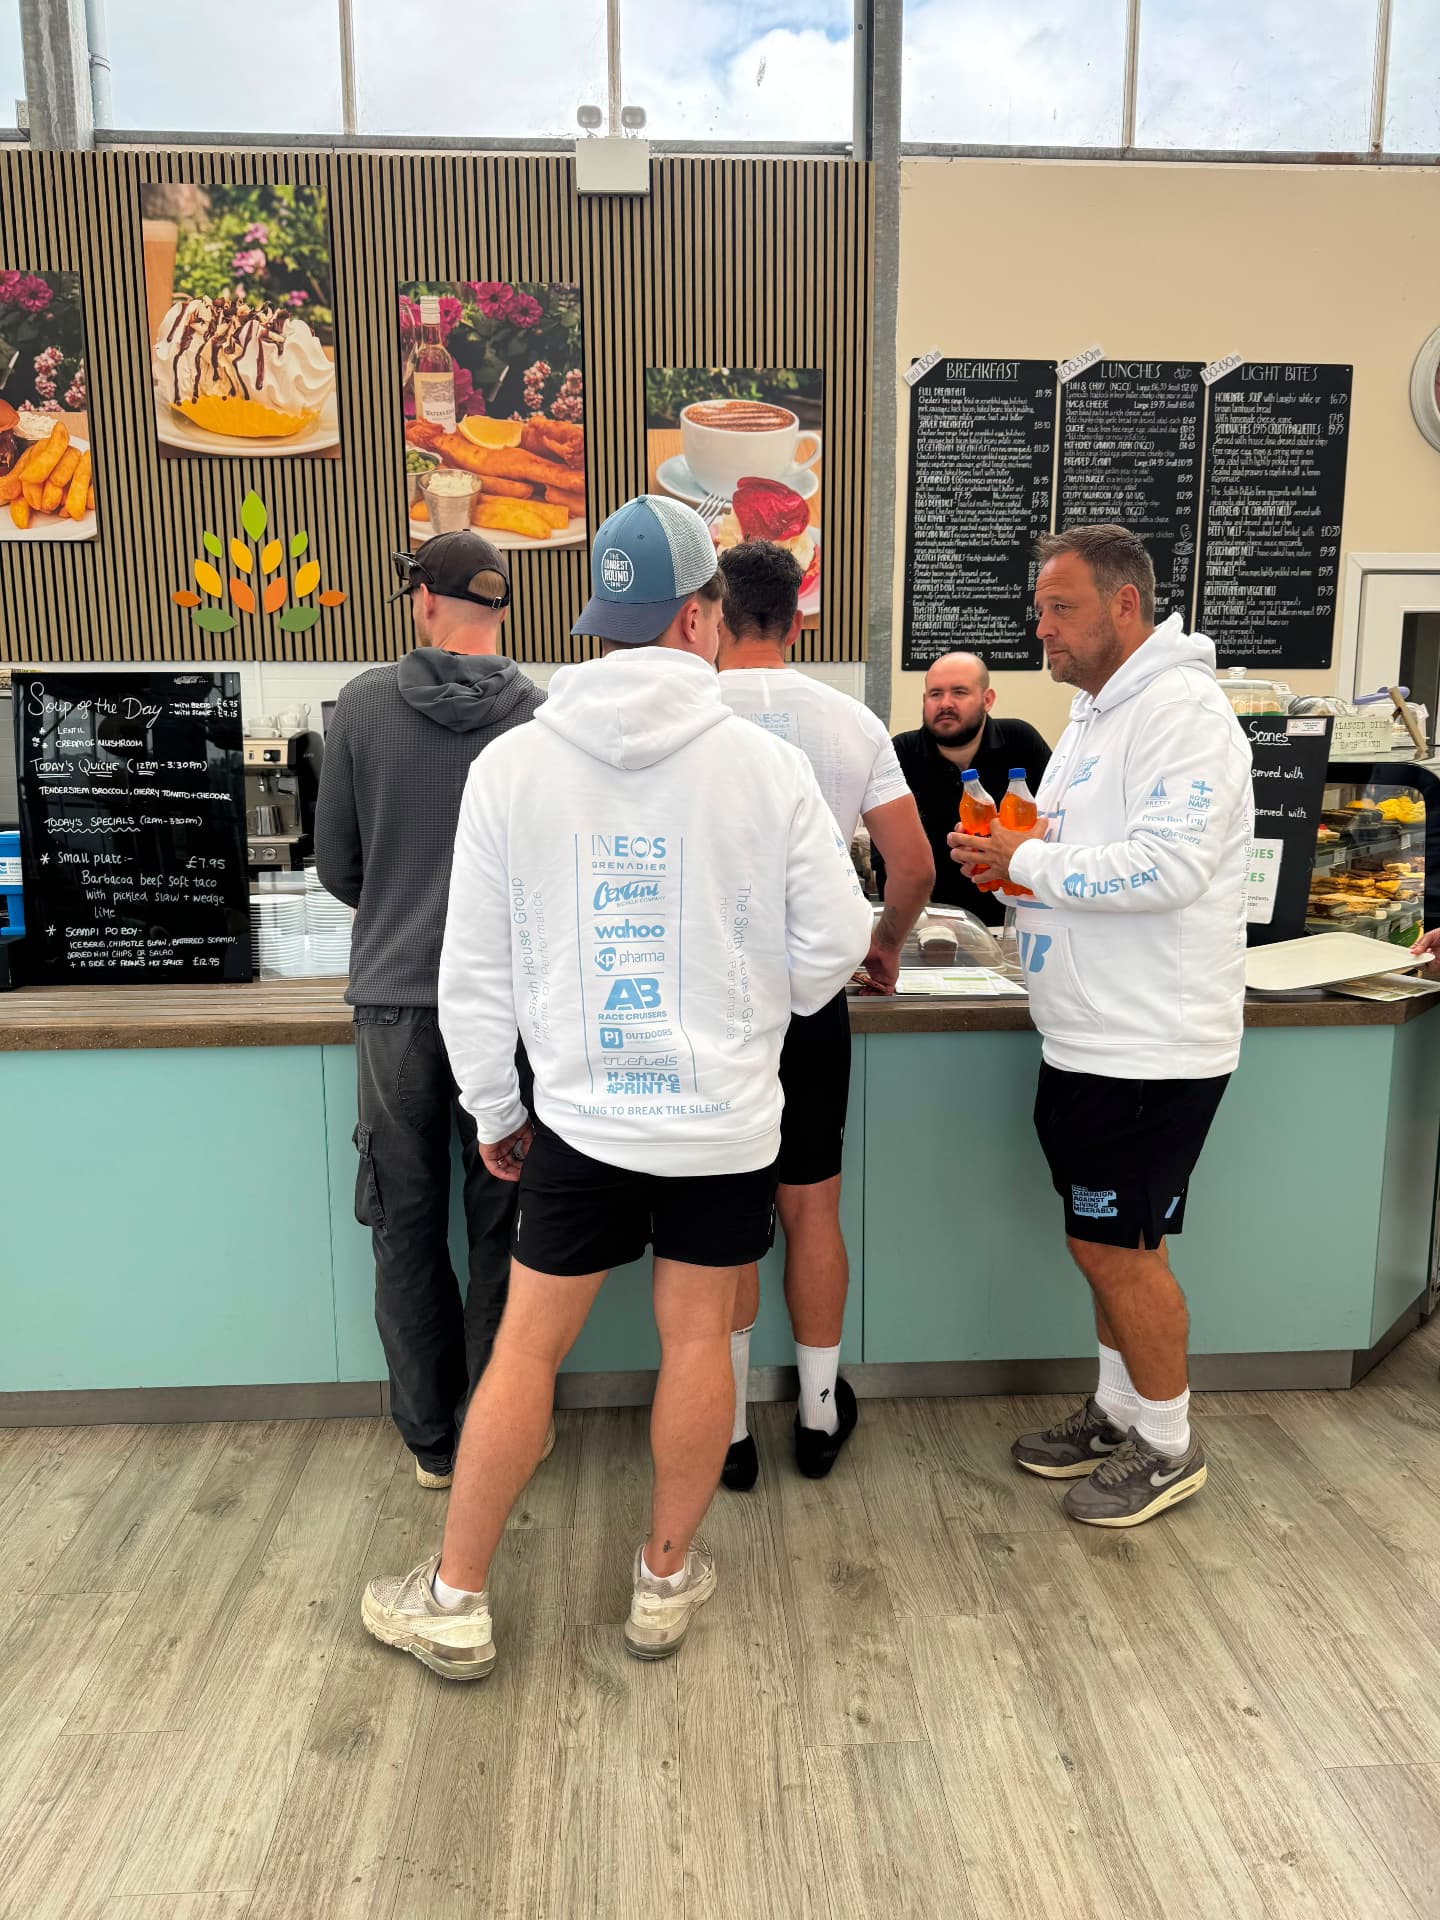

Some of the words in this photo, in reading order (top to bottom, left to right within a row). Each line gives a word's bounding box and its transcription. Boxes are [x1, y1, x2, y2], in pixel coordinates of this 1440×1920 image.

[946, 362, 1020, 379] BREAKFAST
[1101, 363, 1162, 378] LUNCHES
[1242, 366, 1281, 381] LIGHT
[1285, 366, 1319, 381] BITES
[1086, 400, 1109, 408] CHEESE
[604, 570, 629, 582] ROUND
[28, 682, 72, 720] Soup
[77, 700, 92, 719] of
[94, 698, 118, 714] the
[122, 698, 162, 728] Day
[1248, 721, 1289, 743] Scones
[79, 759, 120, 776] QUICHE
[1252, 766, 1281, 779] served
[1284, 766, 1305, 780] with
[39, 786, 89, 795] TENDERSTEM
[1254, 804, 1284, 817] served
[1288, 808, 1308, 819] with
[91, 817, 134, 827] SPECIALS
[592, 834, 667, 859] INEOS
[58, 852, 89, 864] Small
[186, 856, 226, 869] £7.95
[592, 861, 666, 871] GRENADIER
[81, 870, 134, 885] Barbacoa
[140, 872, 164, 888] beef
[193, 877, 217, 888] taco
[1090, 878, 1126, 897] JUST
[1130, 866, 1159, 889] EAT
[114, 892, 148, 905] pickled
[193, 894, 225, 907] wedge
[512, 878, 527, 925] Group
[593, 880, 662, 911] Certini
[737, 884, 752, 912] The
[66, 927, 99, 937] SCAMPI
[594, 919, 666, 939] wahoo
[734, 916, 749, 949] Sixth
[112, 950, 133, 958] CHIPS
[520, 930, 537, 976] House
[619, 947, 665, 966] pharma
[193, 957, 220, 967] £12.95
[604, 978, 662, 1011] AB
[598, 1012, 625, 1021] RACE
[626, 1011, 667, 1020] CRUISERS
[626, 1029, 673, 1040] OUTDOORS
[607, 1072, 680, 1083] HSHTAG
[611, 1106, 624, 1116] TO
[628, 1106, 663, 1116] BREAK
[666, 1106, 687, 1115] THE
[689, 1101, 731, 1114] SILENCE
